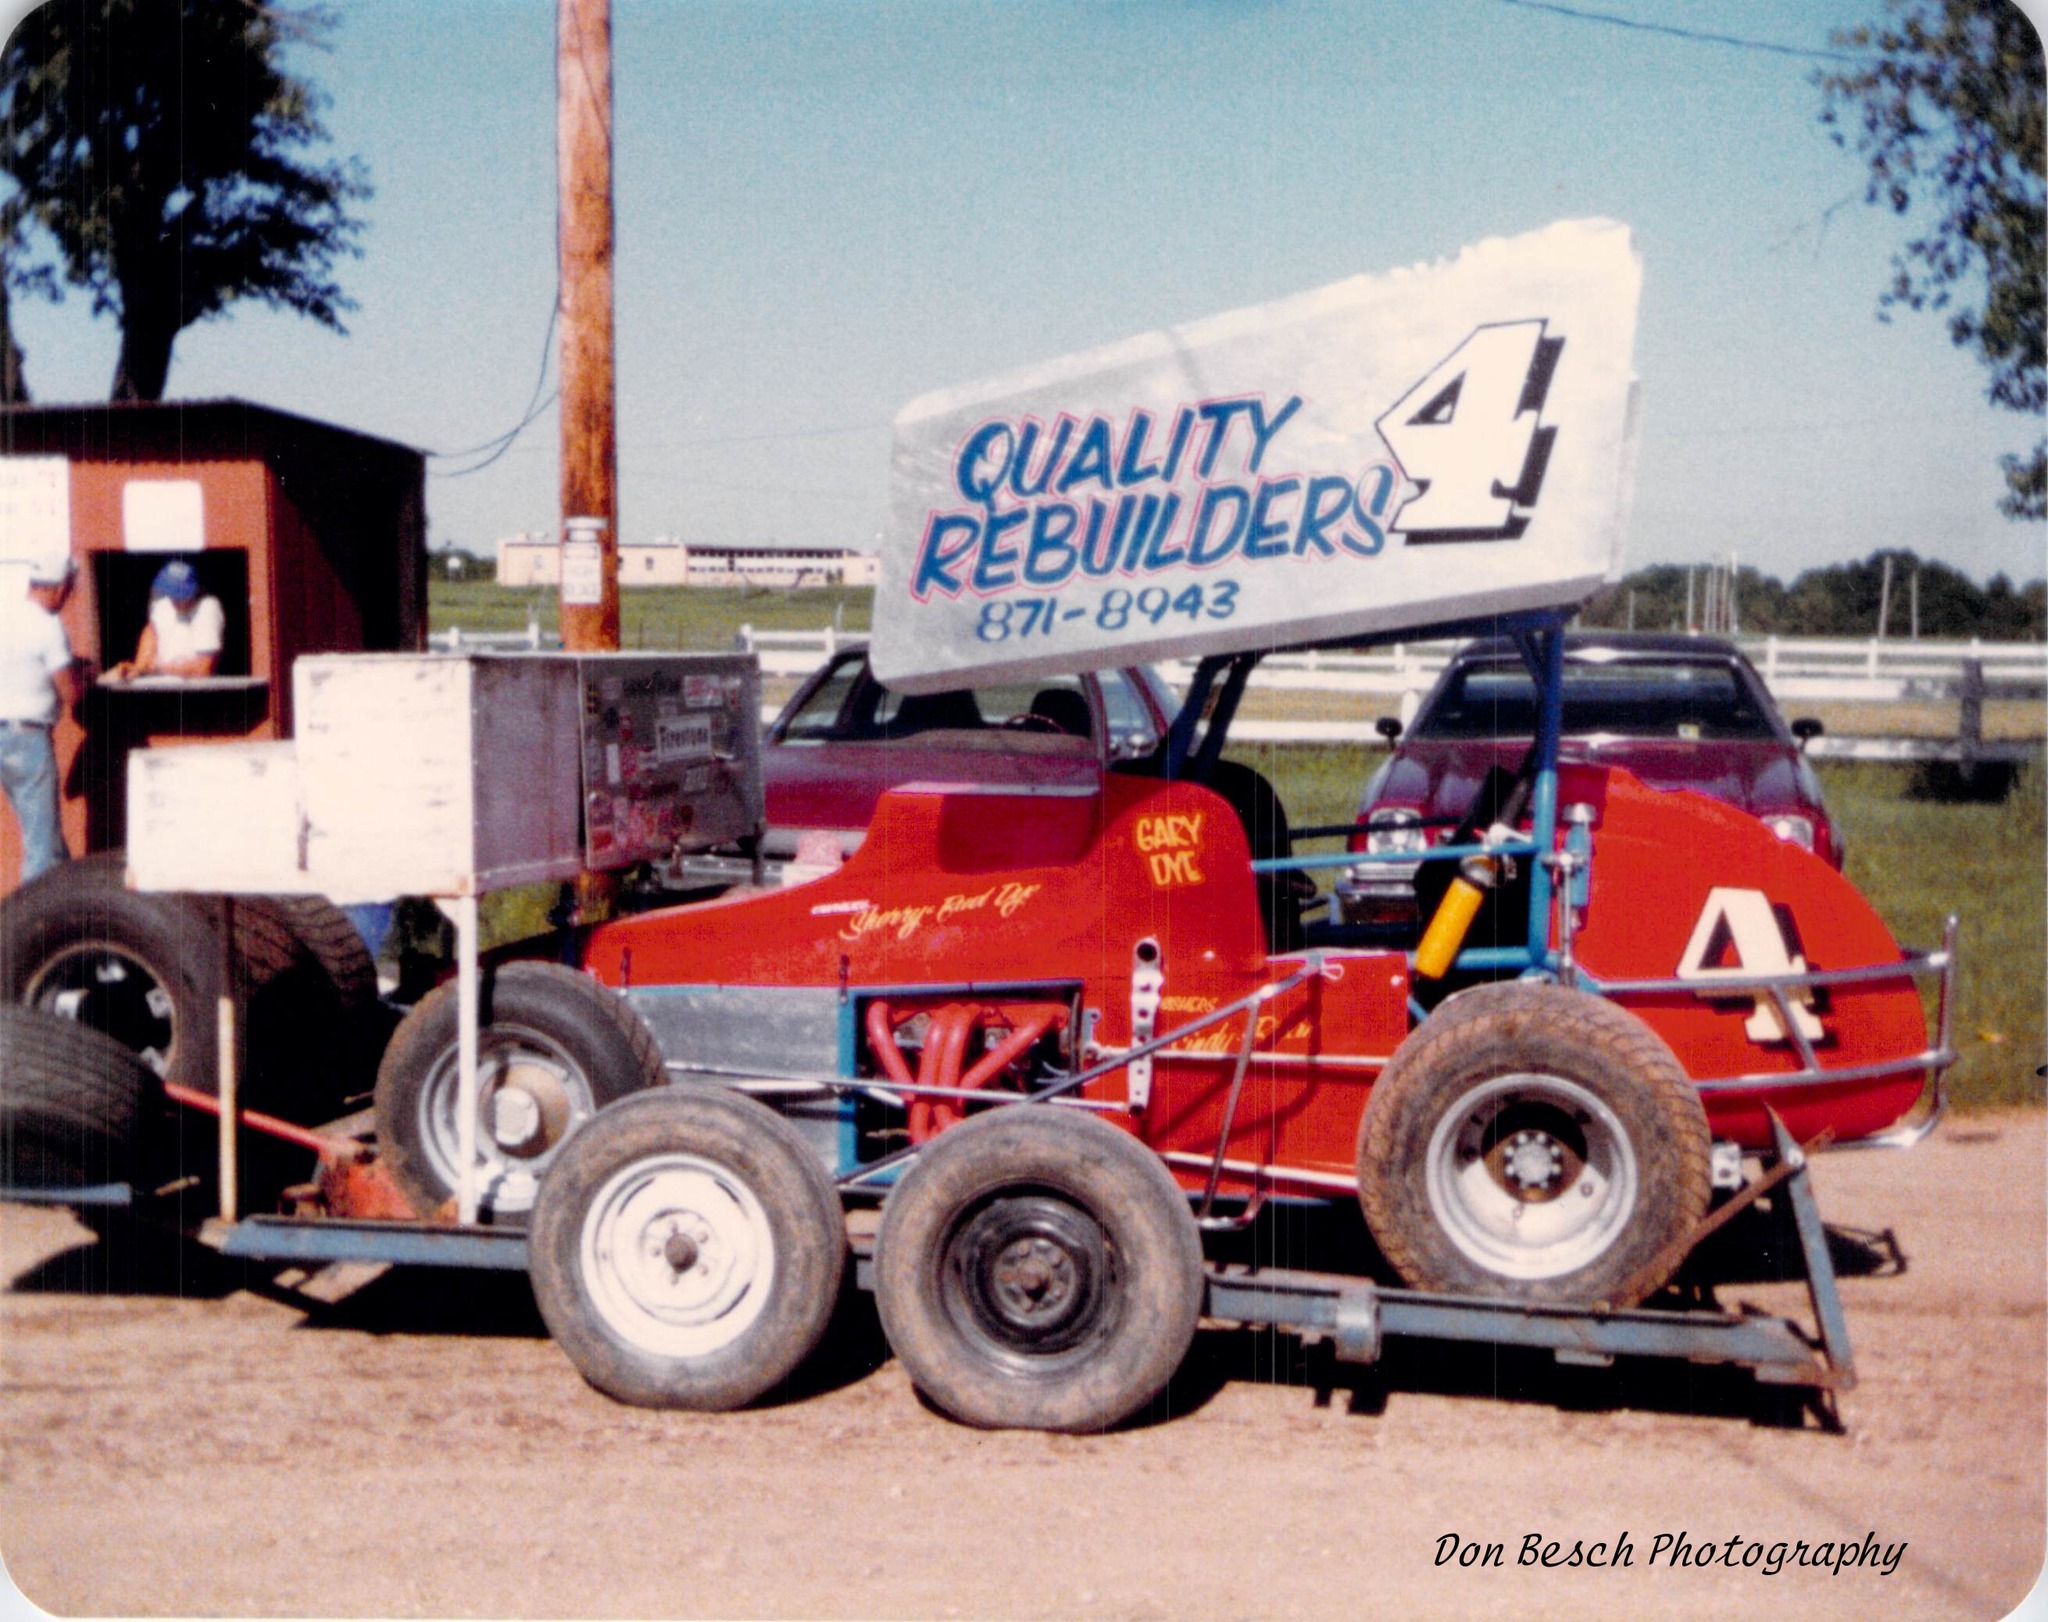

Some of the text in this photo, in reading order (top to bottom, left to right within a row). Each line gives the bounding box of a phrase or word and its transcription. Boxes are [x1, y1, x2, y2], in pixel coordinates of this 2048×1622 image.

[956, 393, 1303, 507] QUALITY
[1374, 317, 1565, 545] 4
[911, 461, 1399, 602] REBUILDERS
[977, 579, 1240, 643] 871-8943
[1136, 812, 1202, 852] GARY
[1149, 850, 1202, 886] DYE
[1675, 885, 1840, 1050] 4
